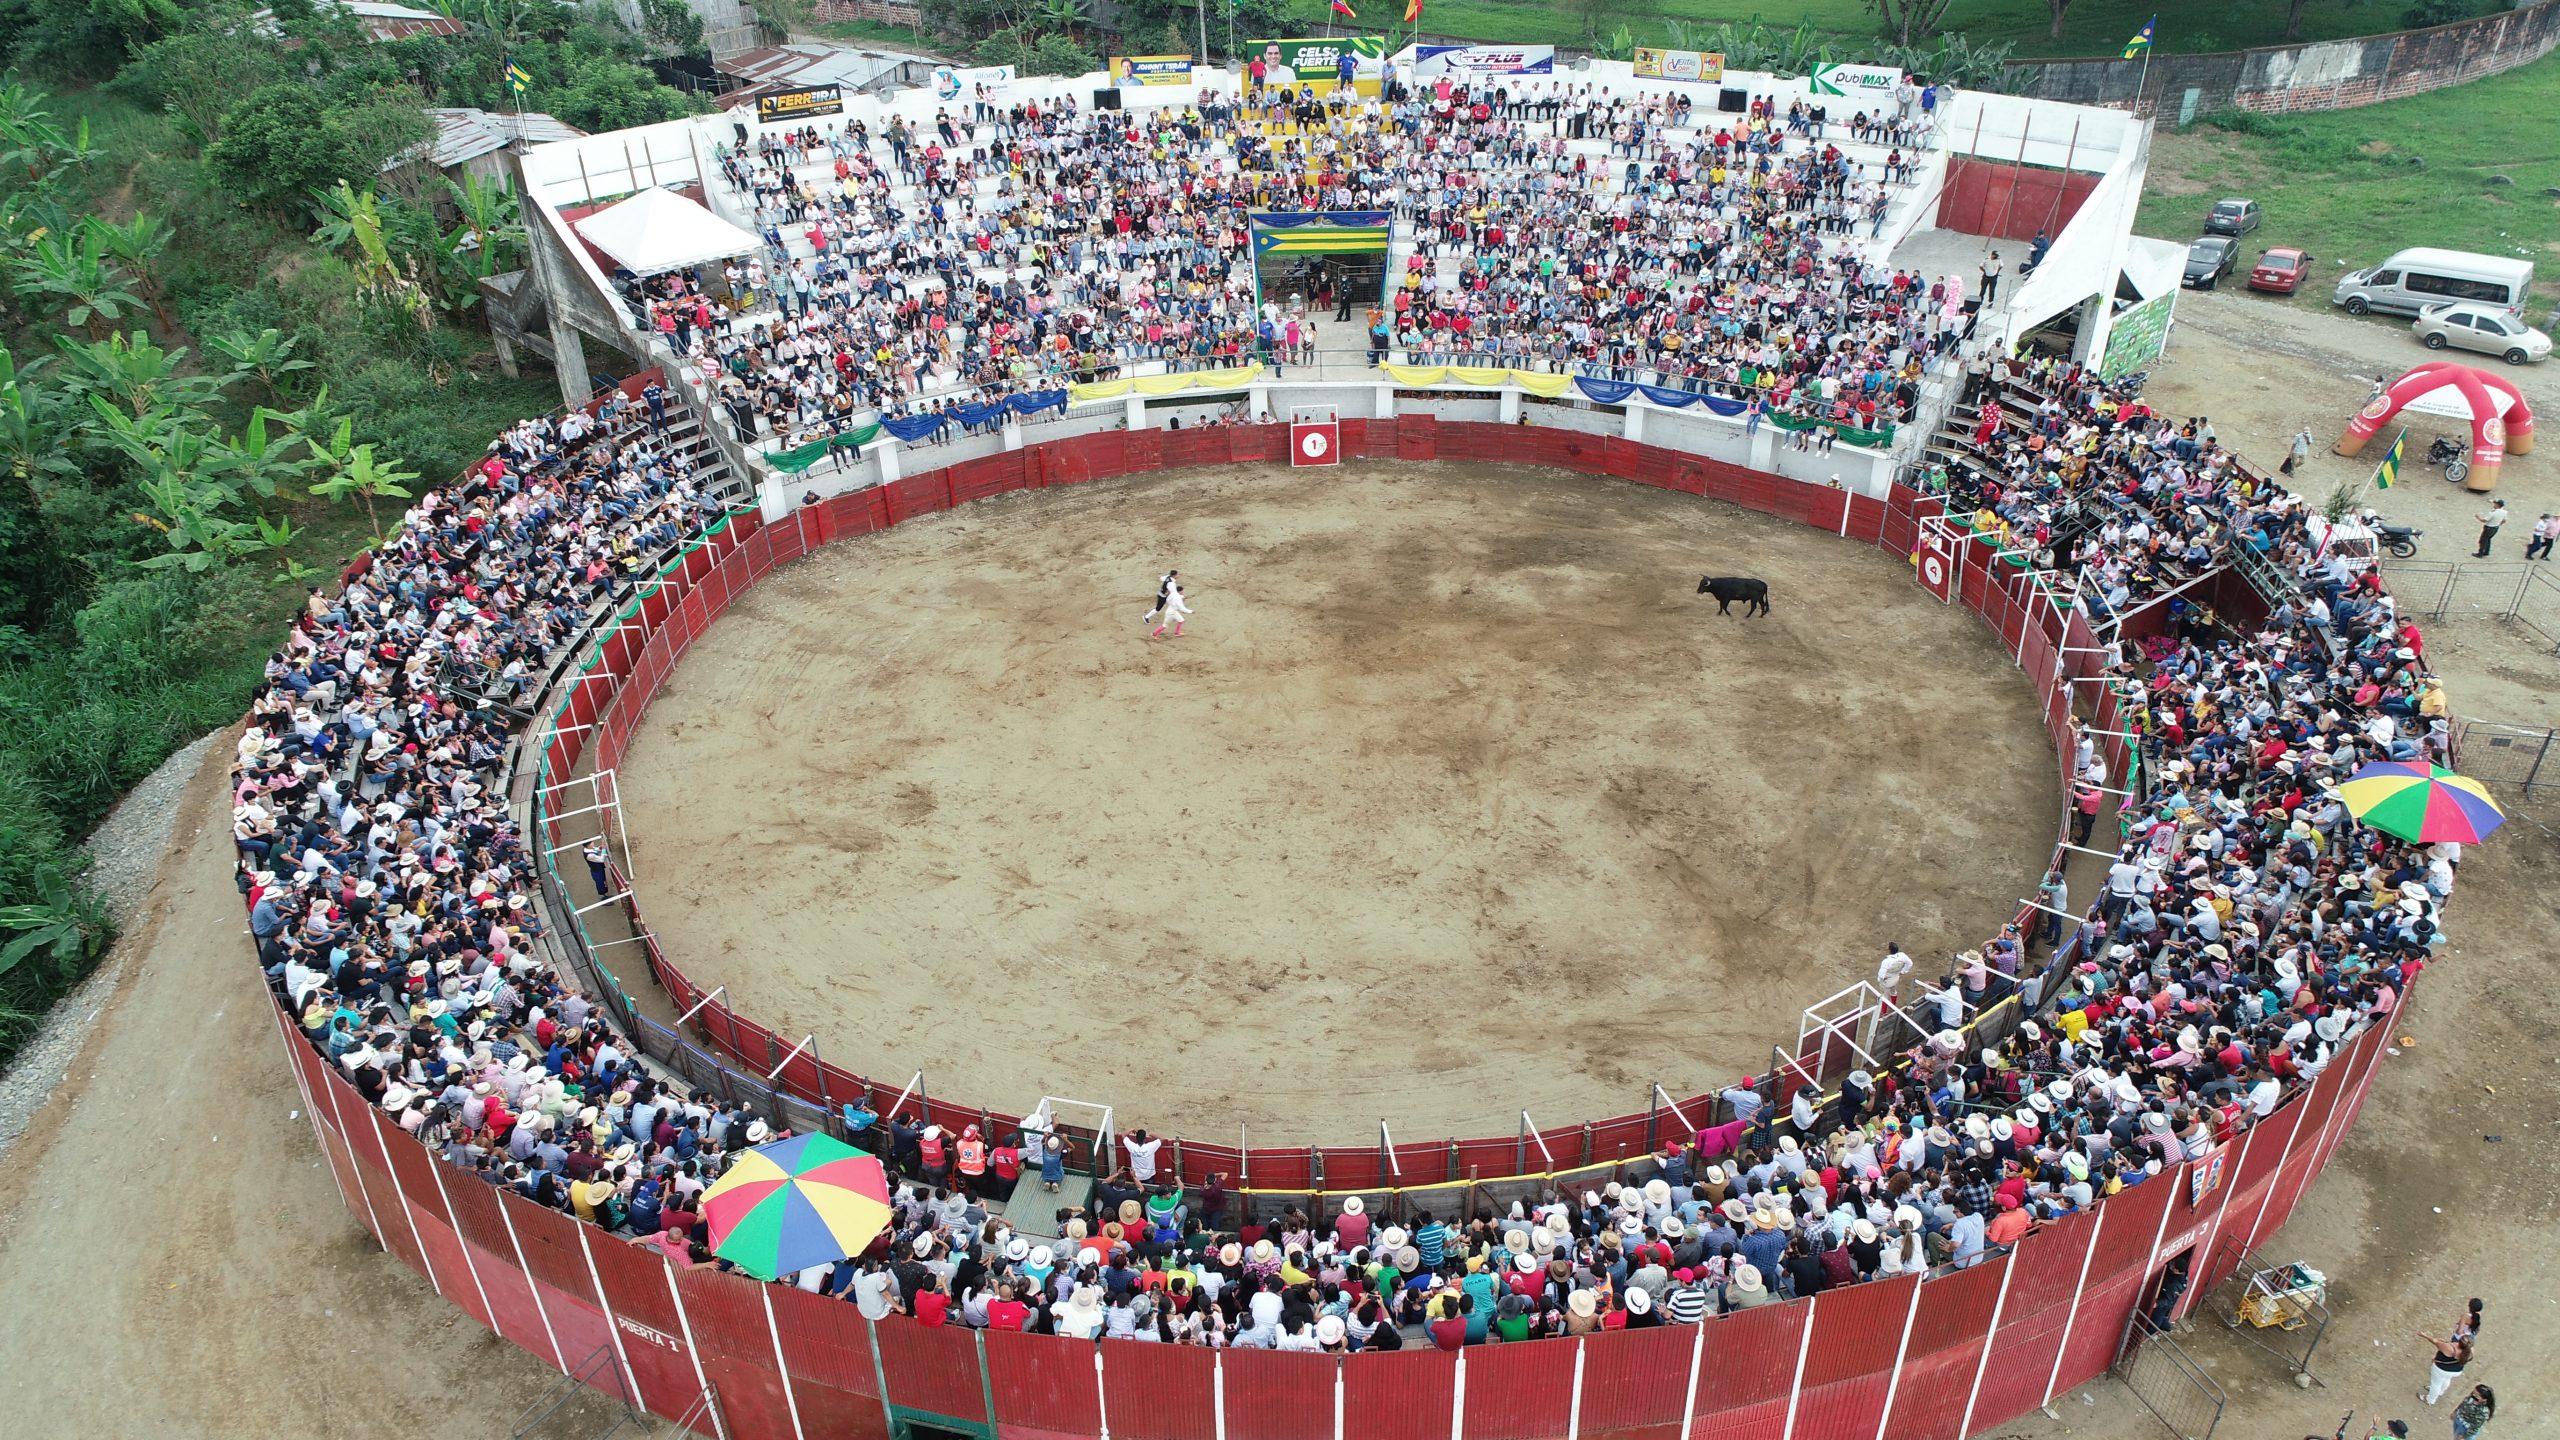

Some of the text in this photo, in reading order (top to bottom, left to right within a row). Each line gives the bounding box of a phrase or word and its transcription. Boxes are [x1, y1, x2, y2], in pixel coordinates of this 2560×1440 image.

[1297, 47, 1340, 58] CELSO
[1291, 58, 1338, 67] FUERTE
[1485, 54, 1524, 63] PLUS
[1164, 61, 1188, 70] TERÁN
[777, 89, 838, 107] FERREIRA
[1311, 439, 1317, 450] 1
[2158, 1221, 2209, 1262] PUERTA 3
[617, 1317, 679, 1353] PUERTA 1
